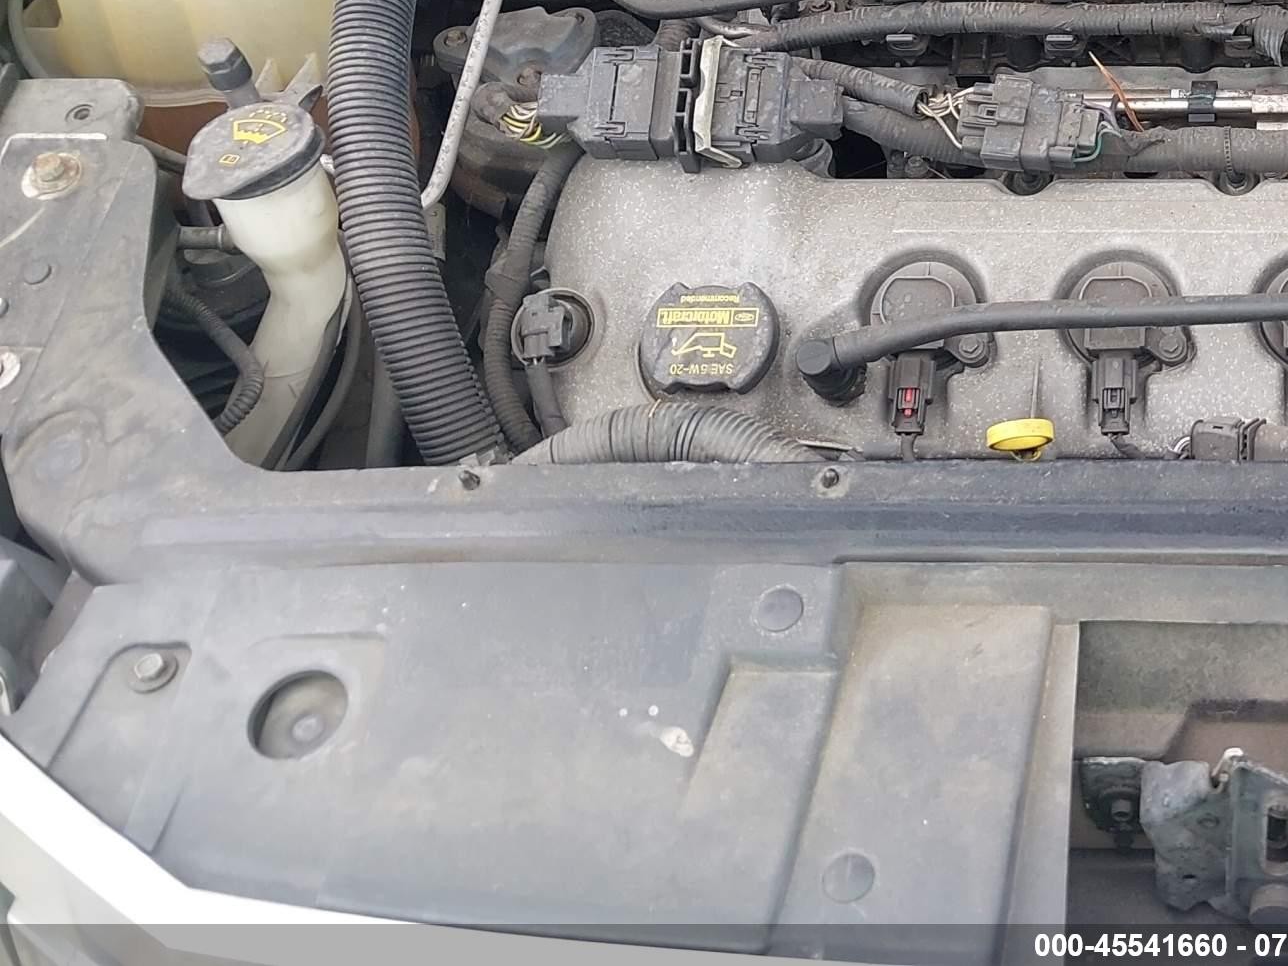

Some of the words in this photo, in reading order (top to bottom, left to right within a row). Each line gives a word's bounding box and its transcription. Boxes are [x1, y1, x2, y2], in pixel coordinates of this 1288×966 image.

[680, 294, 740, 304] Recommended
[661, 310, 730, 324] Motorcraft
[670, 363, 705, 375] 5W-20
[711, 363, 734, 375] SAE
